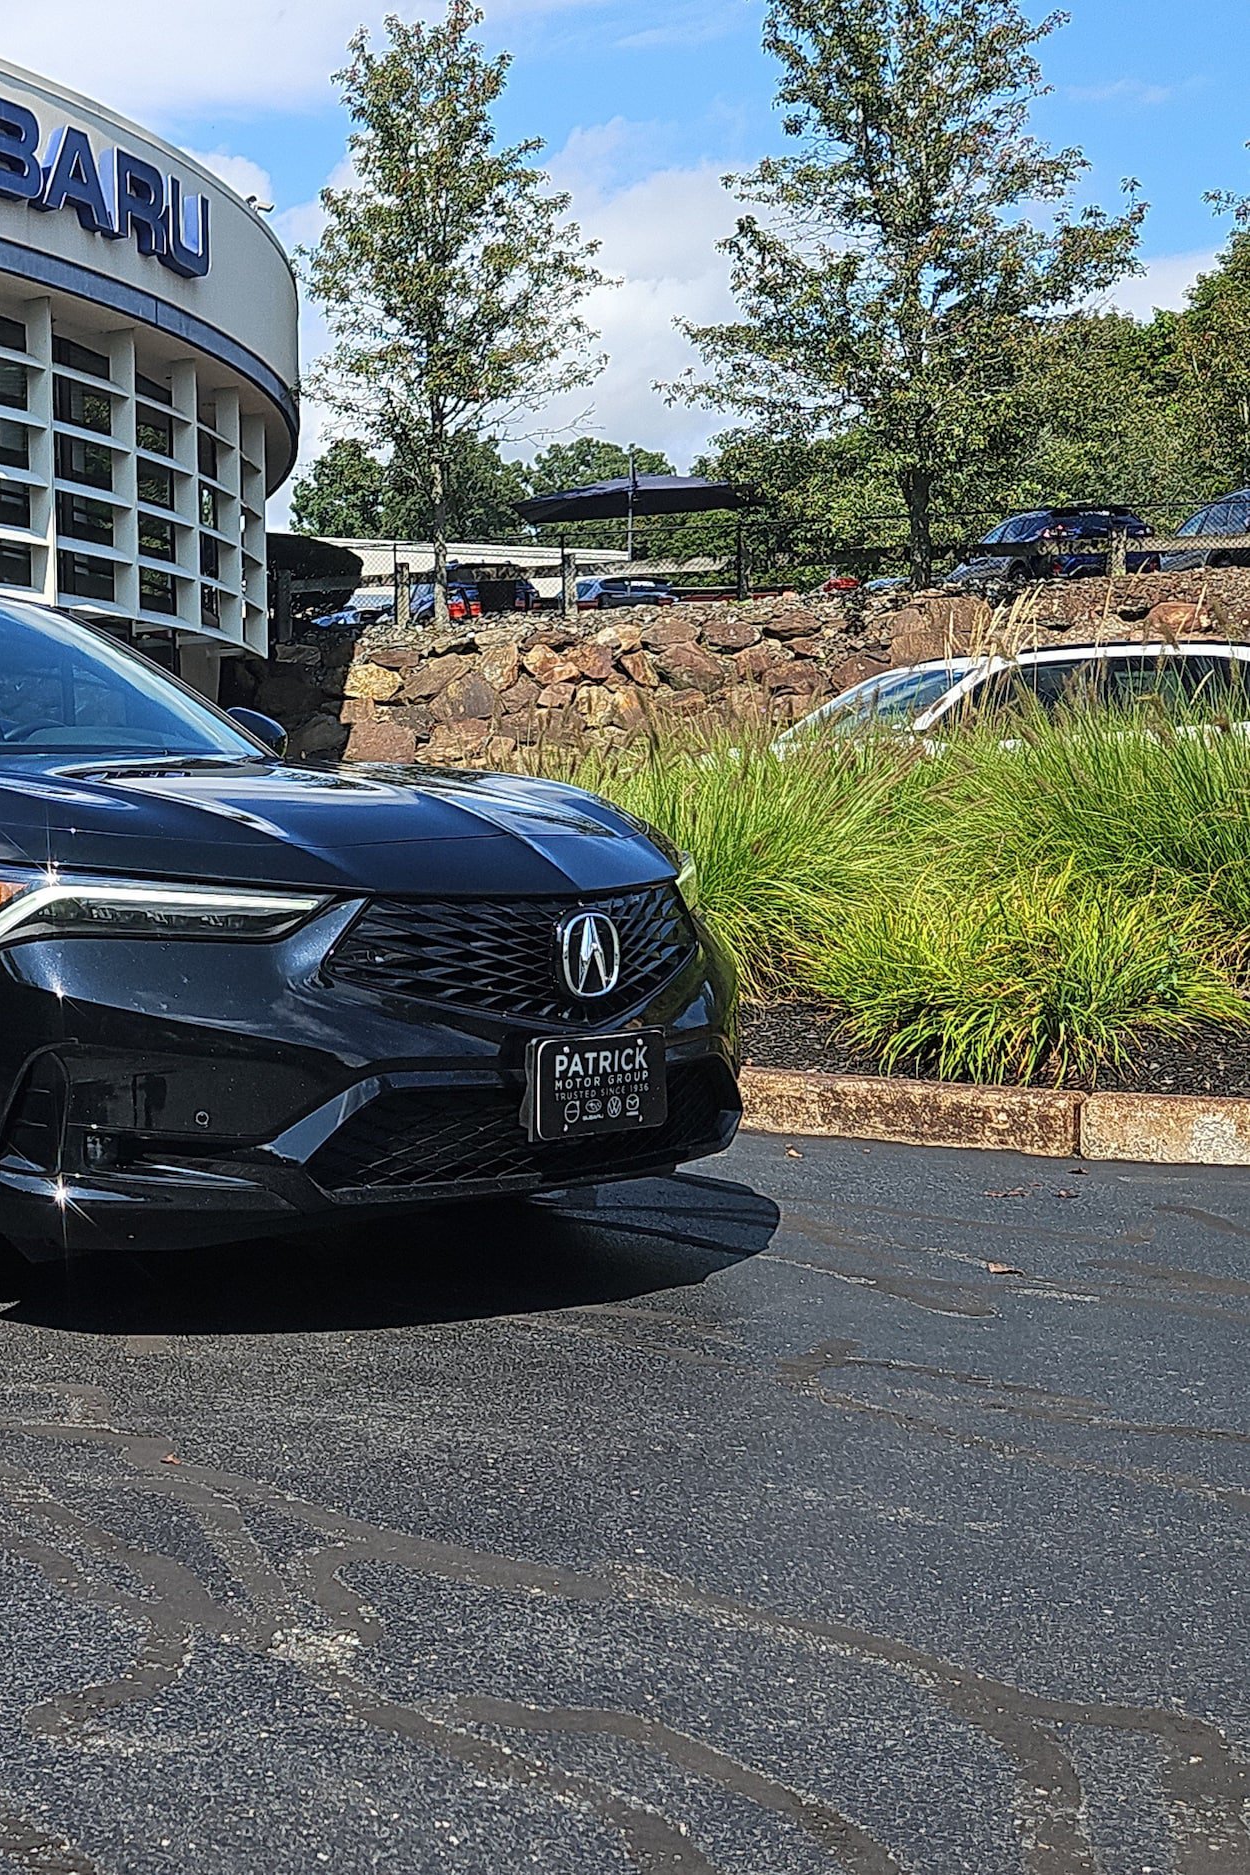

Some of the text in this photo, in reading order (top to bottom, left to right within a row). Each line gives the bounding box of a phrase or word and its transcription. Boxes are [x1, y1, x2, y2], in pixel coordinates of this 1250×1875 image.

[555, 1046, 648, 1079] PATRICK
[555, 1070, 649, 1091] MOTOR GROUP
[555, 1090, 597, 1101] TRUSTED
[600, 1085, 626, 1097] SINCE
